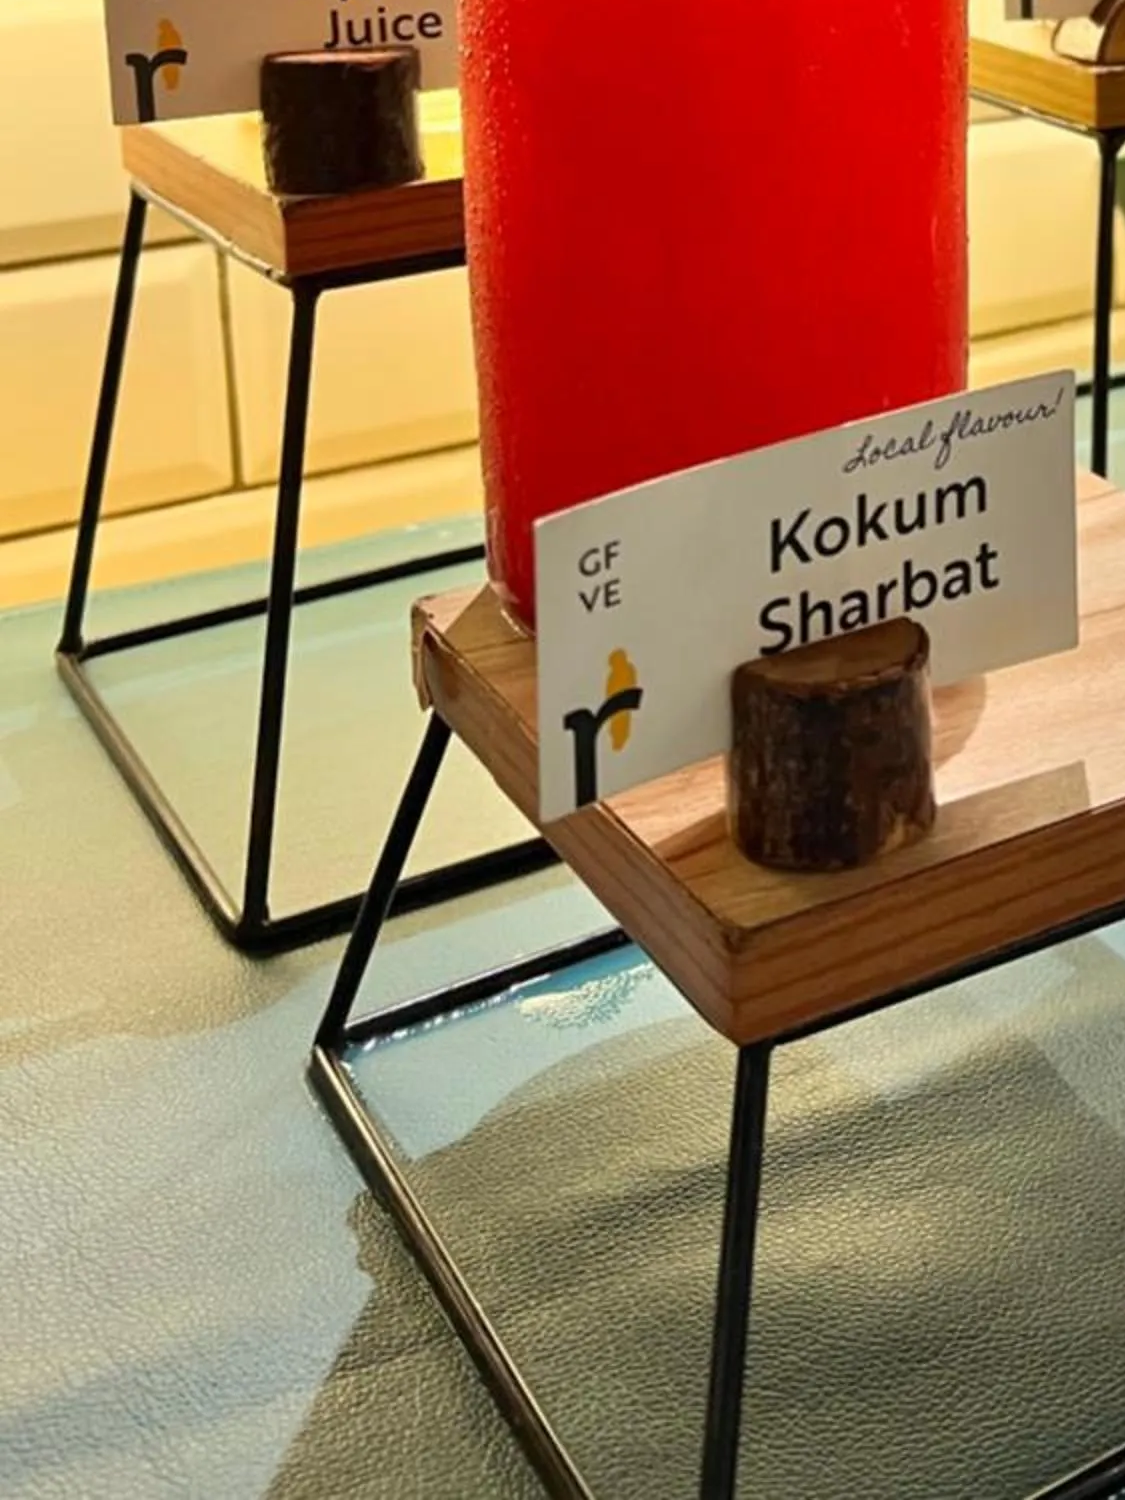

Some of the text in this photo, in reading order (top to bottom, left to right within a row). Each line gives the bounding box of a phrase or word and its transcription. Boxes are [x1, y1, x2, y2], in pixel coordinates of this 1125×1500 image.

[324, 6, 443, 49] Juice
[842, 387, 1065, 474] Local flavour!
[770, 475, 988, 575] Kokum
[578, 541, 620, 577] GF
[578, 578, 622, 613] VE
[758, 542, 1000, 655] Sharbat
